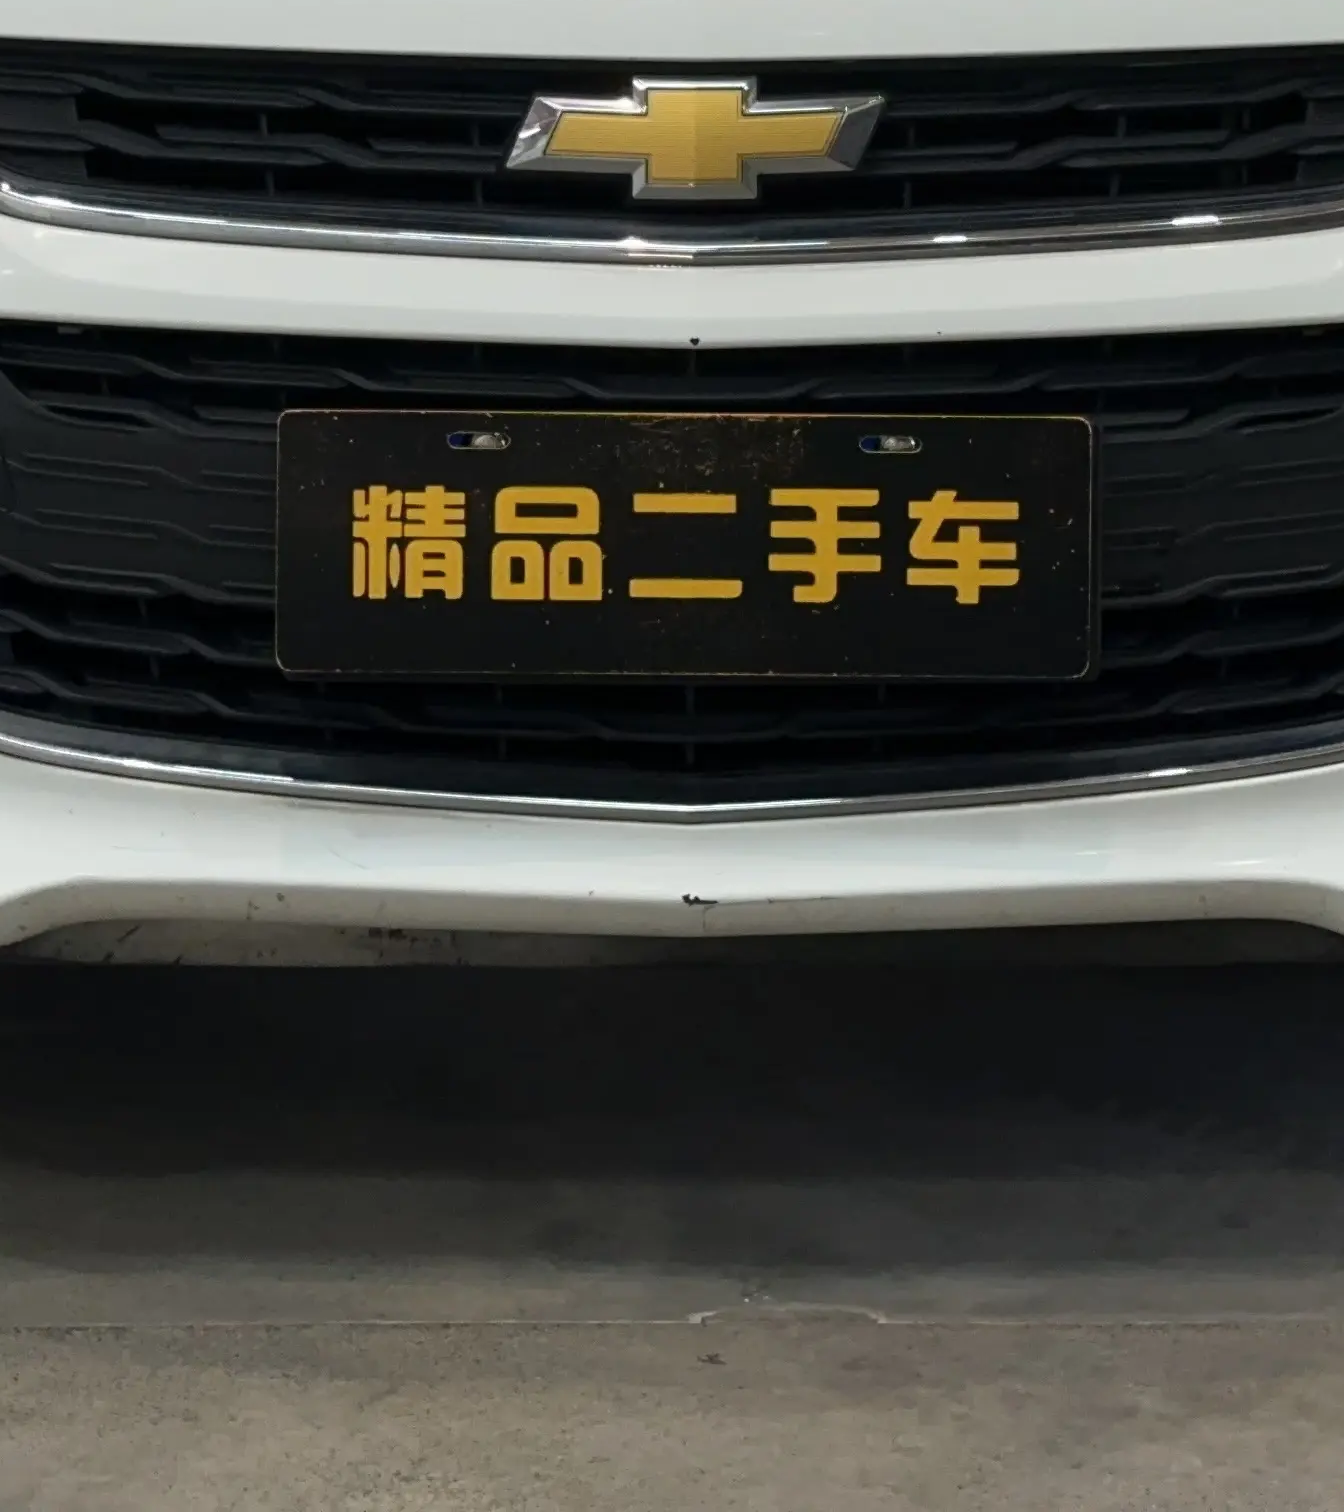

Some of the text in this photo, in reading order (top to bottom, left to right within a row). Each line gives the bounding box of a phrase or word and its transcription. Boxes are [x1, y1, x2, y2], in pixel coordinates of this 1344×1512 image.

[351, 485, 1020, 604] 精品二手车
